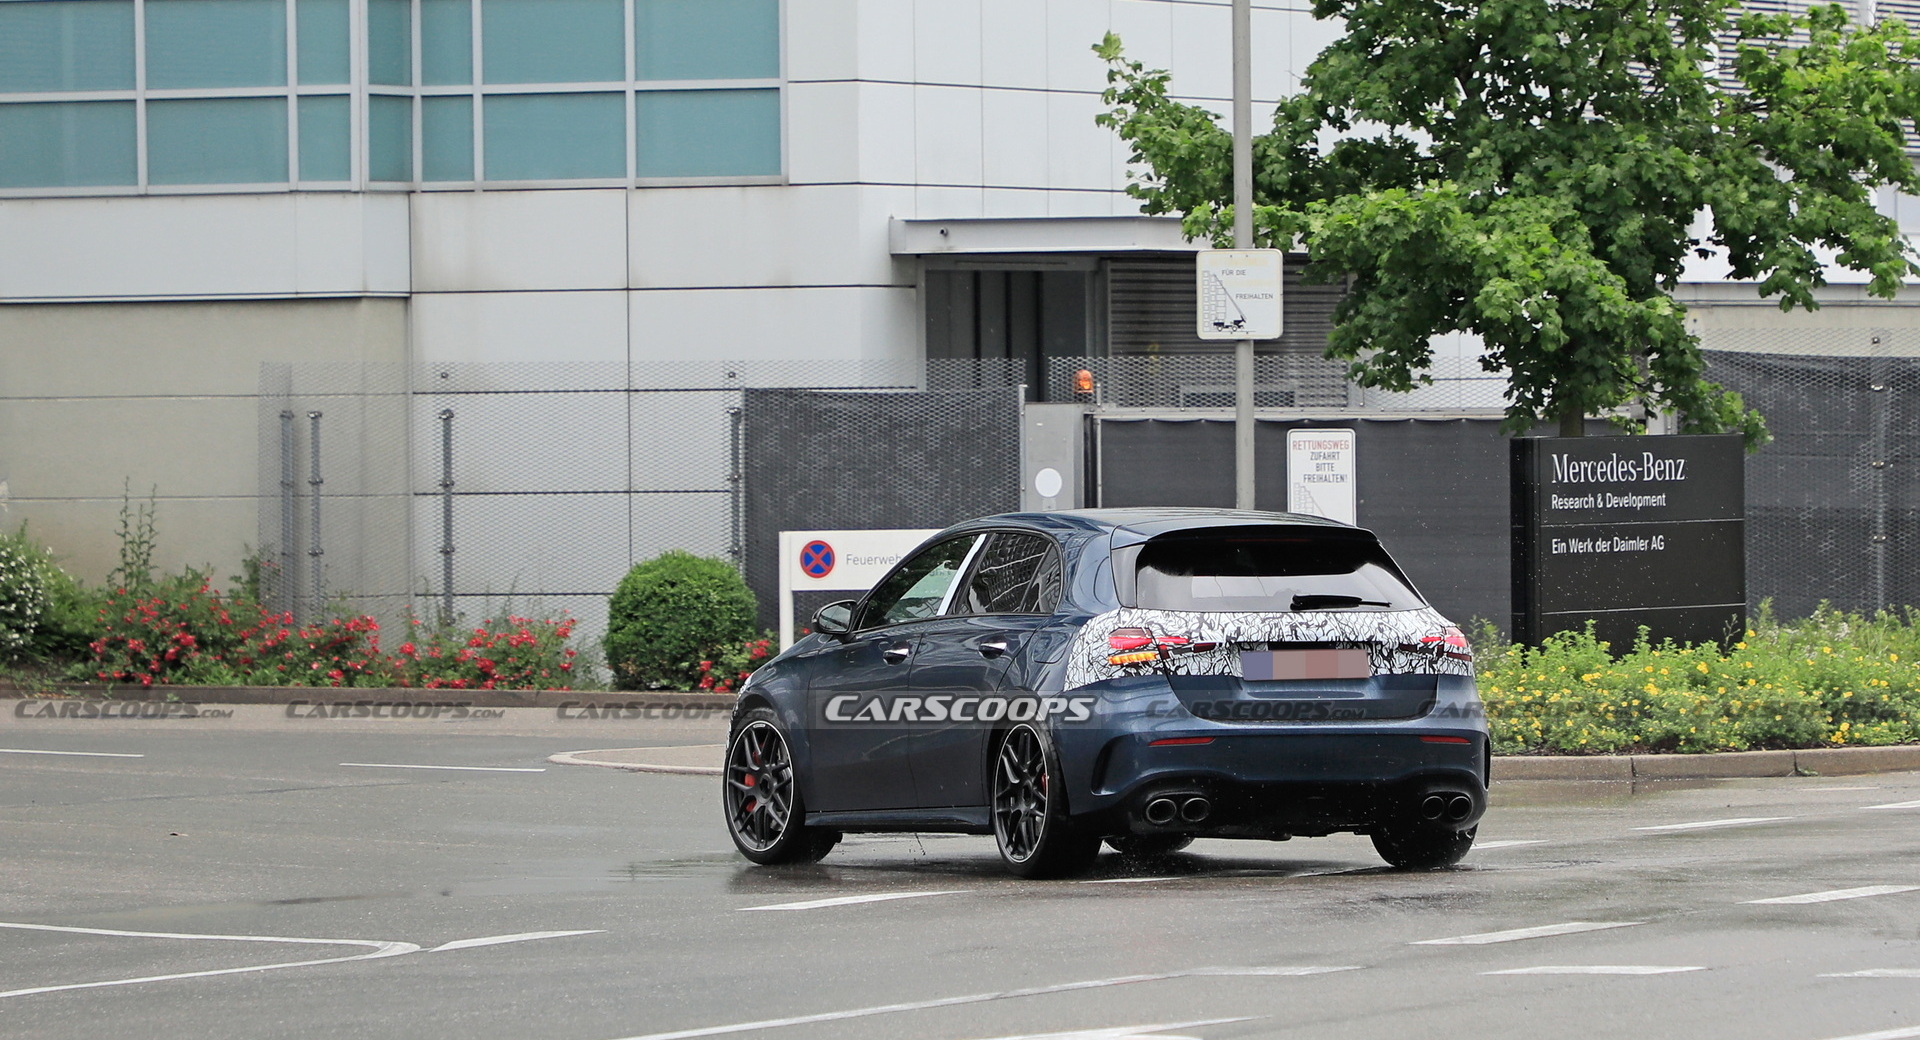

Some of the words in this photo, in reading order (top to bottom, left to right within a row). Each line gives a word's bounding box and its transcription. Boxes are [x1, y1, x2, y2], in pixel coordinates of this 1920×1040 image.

[1221, 268, 1234, 276] FÜR
[1292, 440, 1350, 450] RETTUNGSWEG
[1310, 451, 1340, 461] ZUFAHRT
[1315, 462, 1335, 472] BITTE
[1551, 452, 1686, 484] Mercedes-Benz
[1303, 474, 1348, 483] FREIHALTEN!
[1551, 493, 1595, 510] Research
[1597, 493, 1603, 508] &
[1606, 492, 1667, 511] Development
[1552, 539, 1567, 554] Ein
[1569, 538, 1594, 554] Werk
[1596, 537, 1611, 553] der
[1613, 536, 1649, 552] Daimler
[1651, 534, 1665, 551] AG
